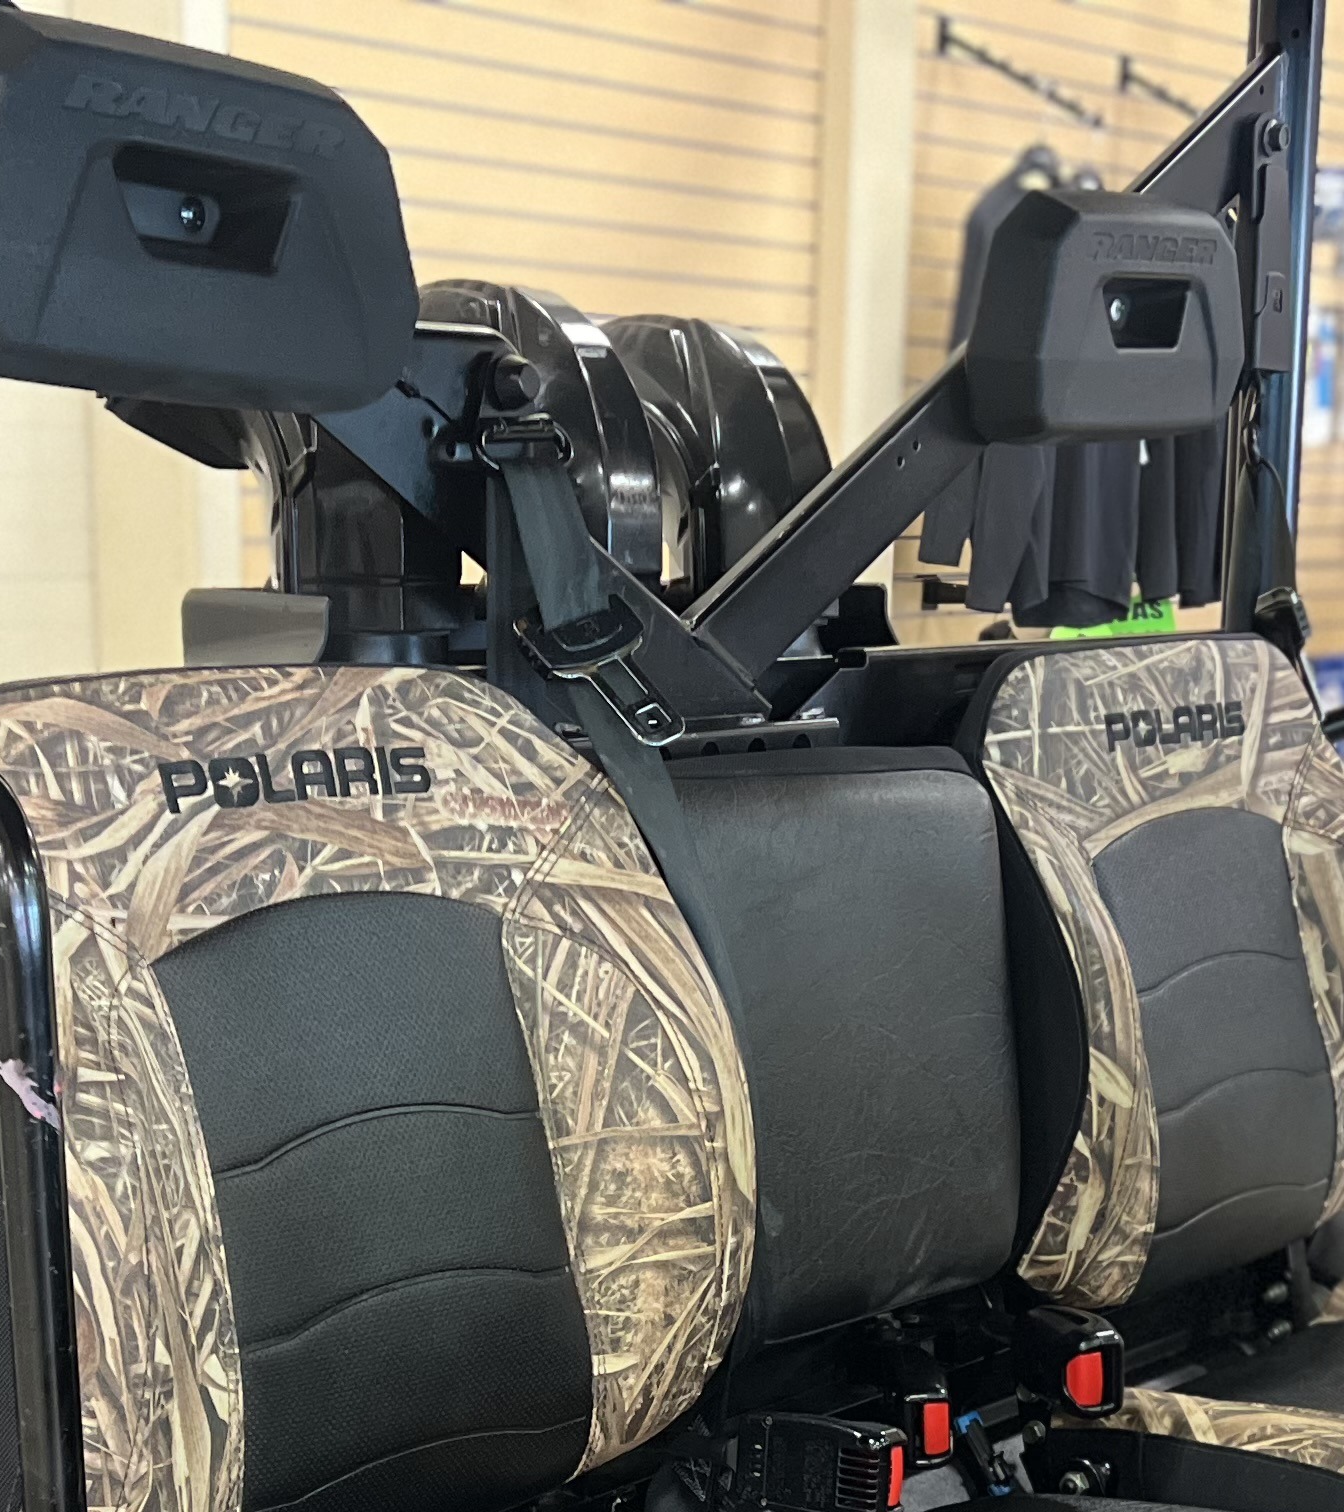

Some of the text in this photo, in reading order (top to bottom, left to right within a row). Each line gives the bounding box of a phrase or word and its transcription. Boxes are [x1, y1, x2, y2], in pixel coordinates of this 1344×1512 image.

[62, 74, 346, 158] RANGER
[1090, 231, 1217, 265] RANGER
[1131, 600, 1164, 620] AS
[1104, 701, 1246, 752] POLARIS
[158, 746, 432, 814] POLARIS
